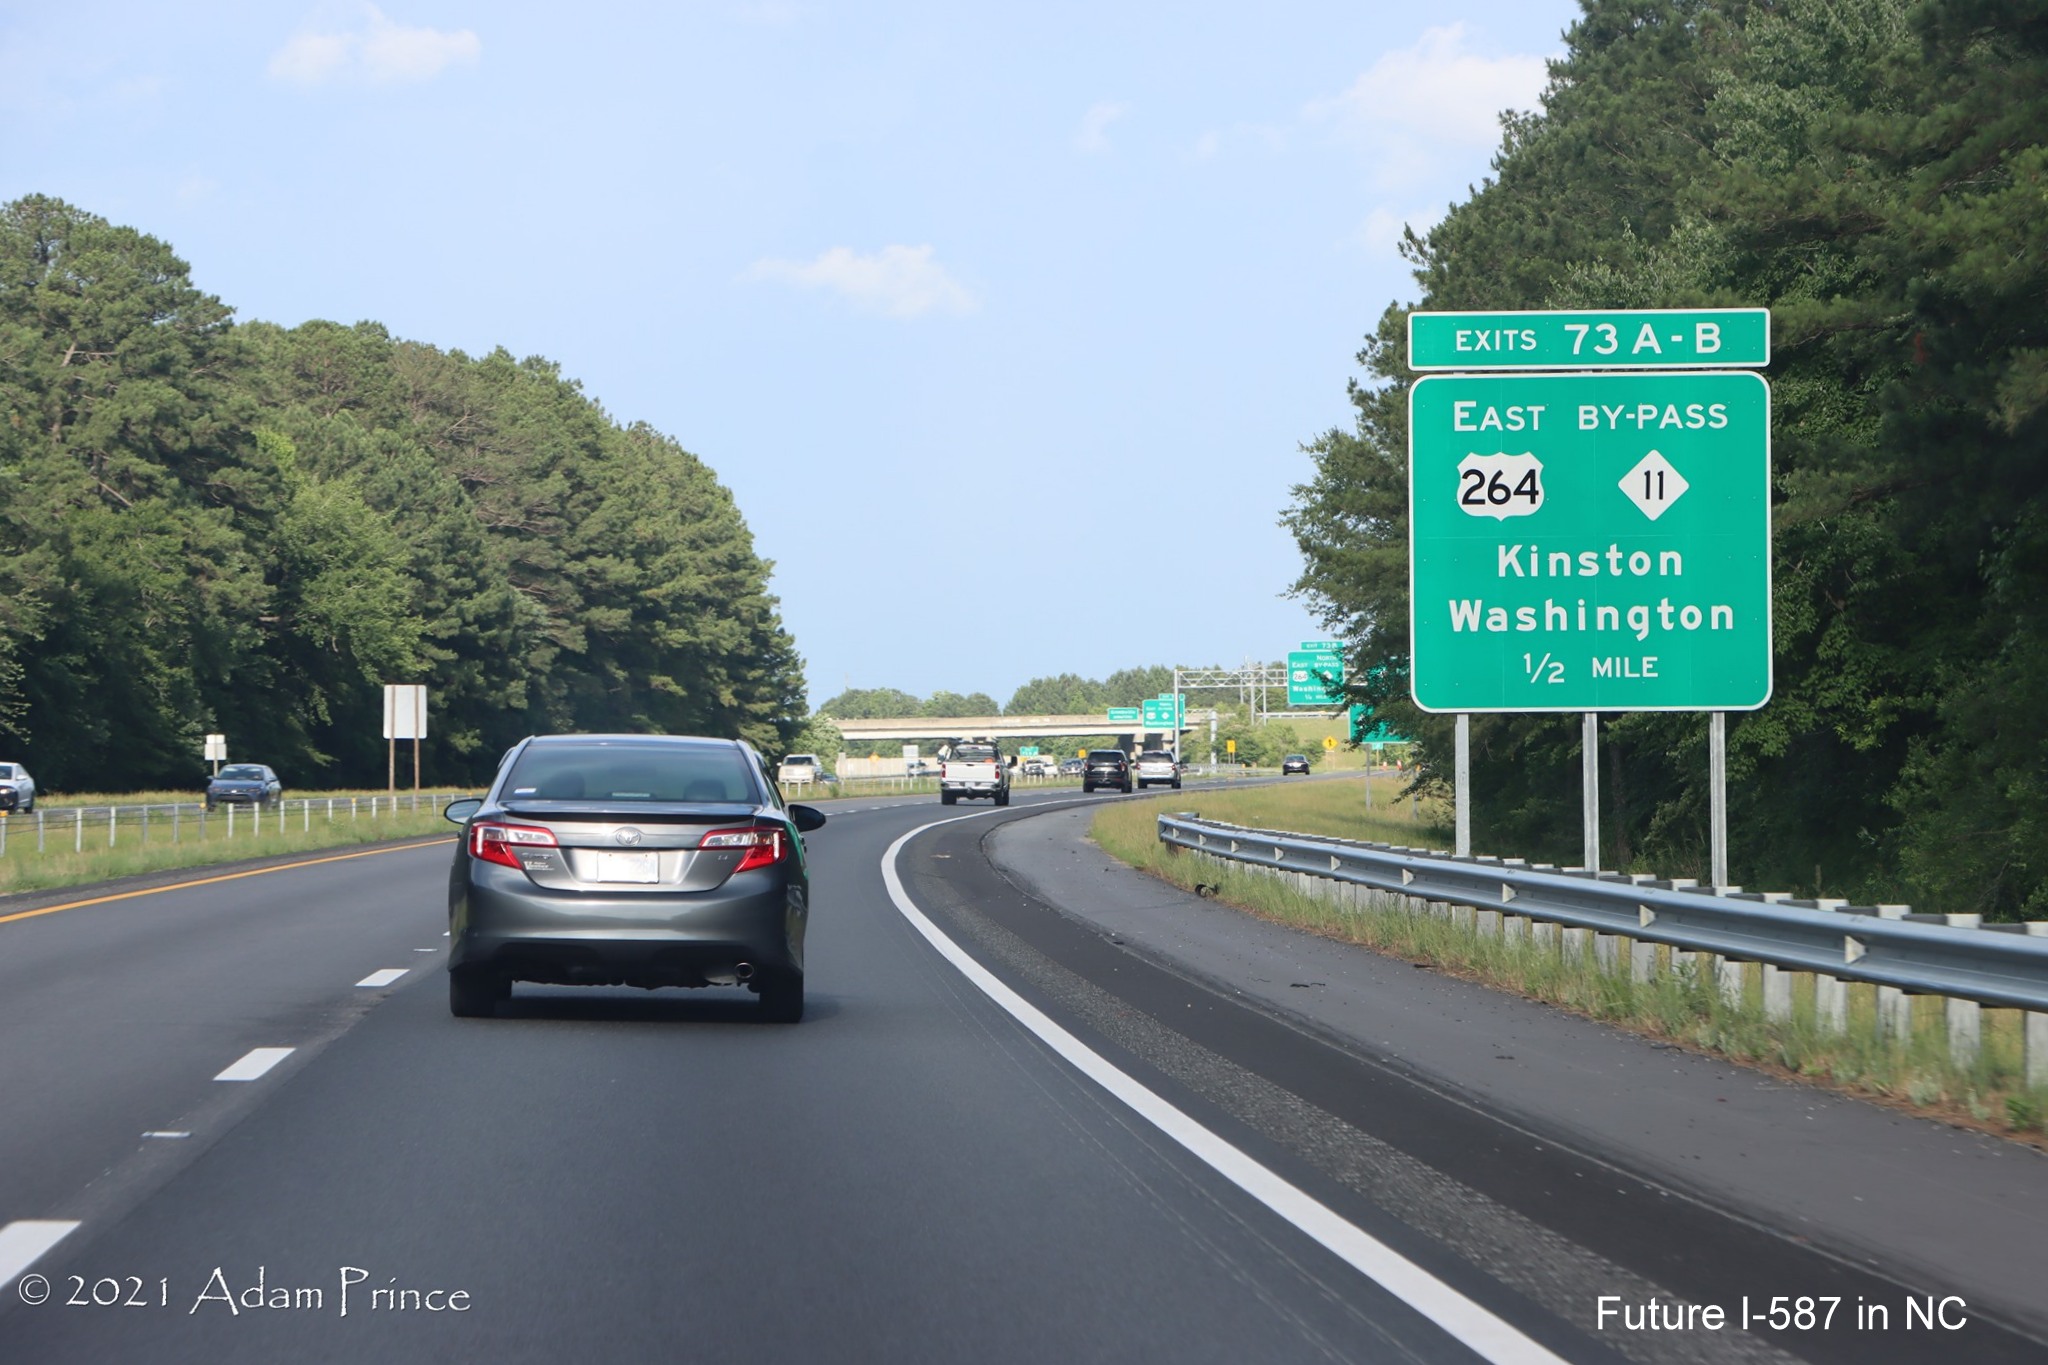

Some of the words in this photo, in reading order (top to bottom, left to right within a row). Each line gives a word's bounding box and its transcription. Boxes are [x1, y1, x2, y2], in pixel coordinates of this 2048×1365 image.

[1456, 329, 1537, 351] EXITS
[1453, 400, 1546, 432] EAST
[1578, 403, 1728, 430] BY-PASS
[1461, 468, 1540, 505] 264
[1643, 469, 1665, 501] 11
[1498, 543, 1682, 578] Kinston
[1448, 597, 1734, 642] Washington
[1592, 656, 1659, 678] MILE
